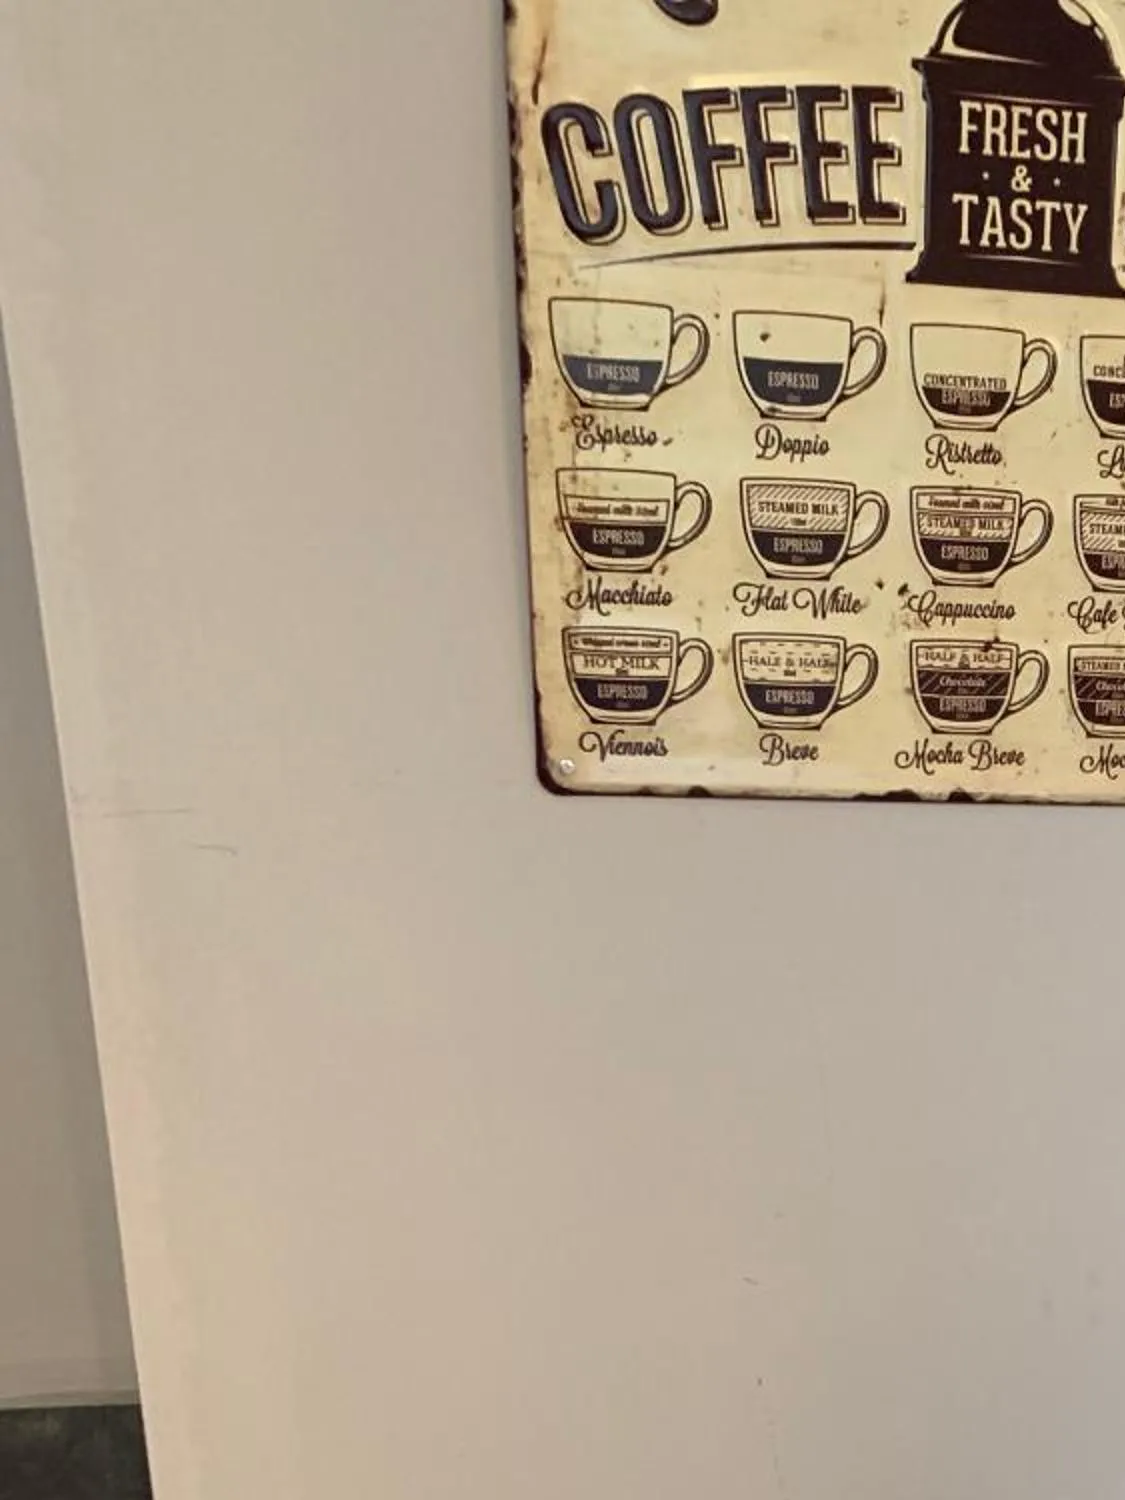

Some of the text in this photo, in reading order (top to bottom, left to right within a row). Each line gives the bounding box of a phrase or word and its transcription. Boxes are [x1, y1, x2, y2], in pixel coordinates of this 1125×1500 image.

[958, 100, 1088, 165] FRESH
[541, 84, 907, 246] COFFEE
[1010, 165, 1033, 193] &
[952, 193, 1089, 255] TASTY
[586, 363, 641, 383] ESPRESSO
[767, 370, 820, 390] ESPRESSO
[923, 373, 1008, 390] CONCENTRATED
[571, 413, 658, 453] Espresso
[755, 423, 830, 463] Doppio
[924, 433, 1003, 475] Ristretto
[757, 501, 839, 516] STEAMED MILK
[592, 527, 645, 546] ESPRESSO
[773, 536, 823, 554] ESPRESSO
[940, 544, 990, 561] ESPRESSO
[565, 575, 674, 617] Macchiato
[733, 582, 863, 620] Flat White
[907, 589, 1017, 628] Cappuccino
[1067, 596, 1118, 635] Cafe
[765, 689, 815, 705] ESPRESSO
[578, 729, 670, 763] Viennois
[759, 733, 820, 767] Breve
[894, 738, 1026, 775] Mocha Breve
